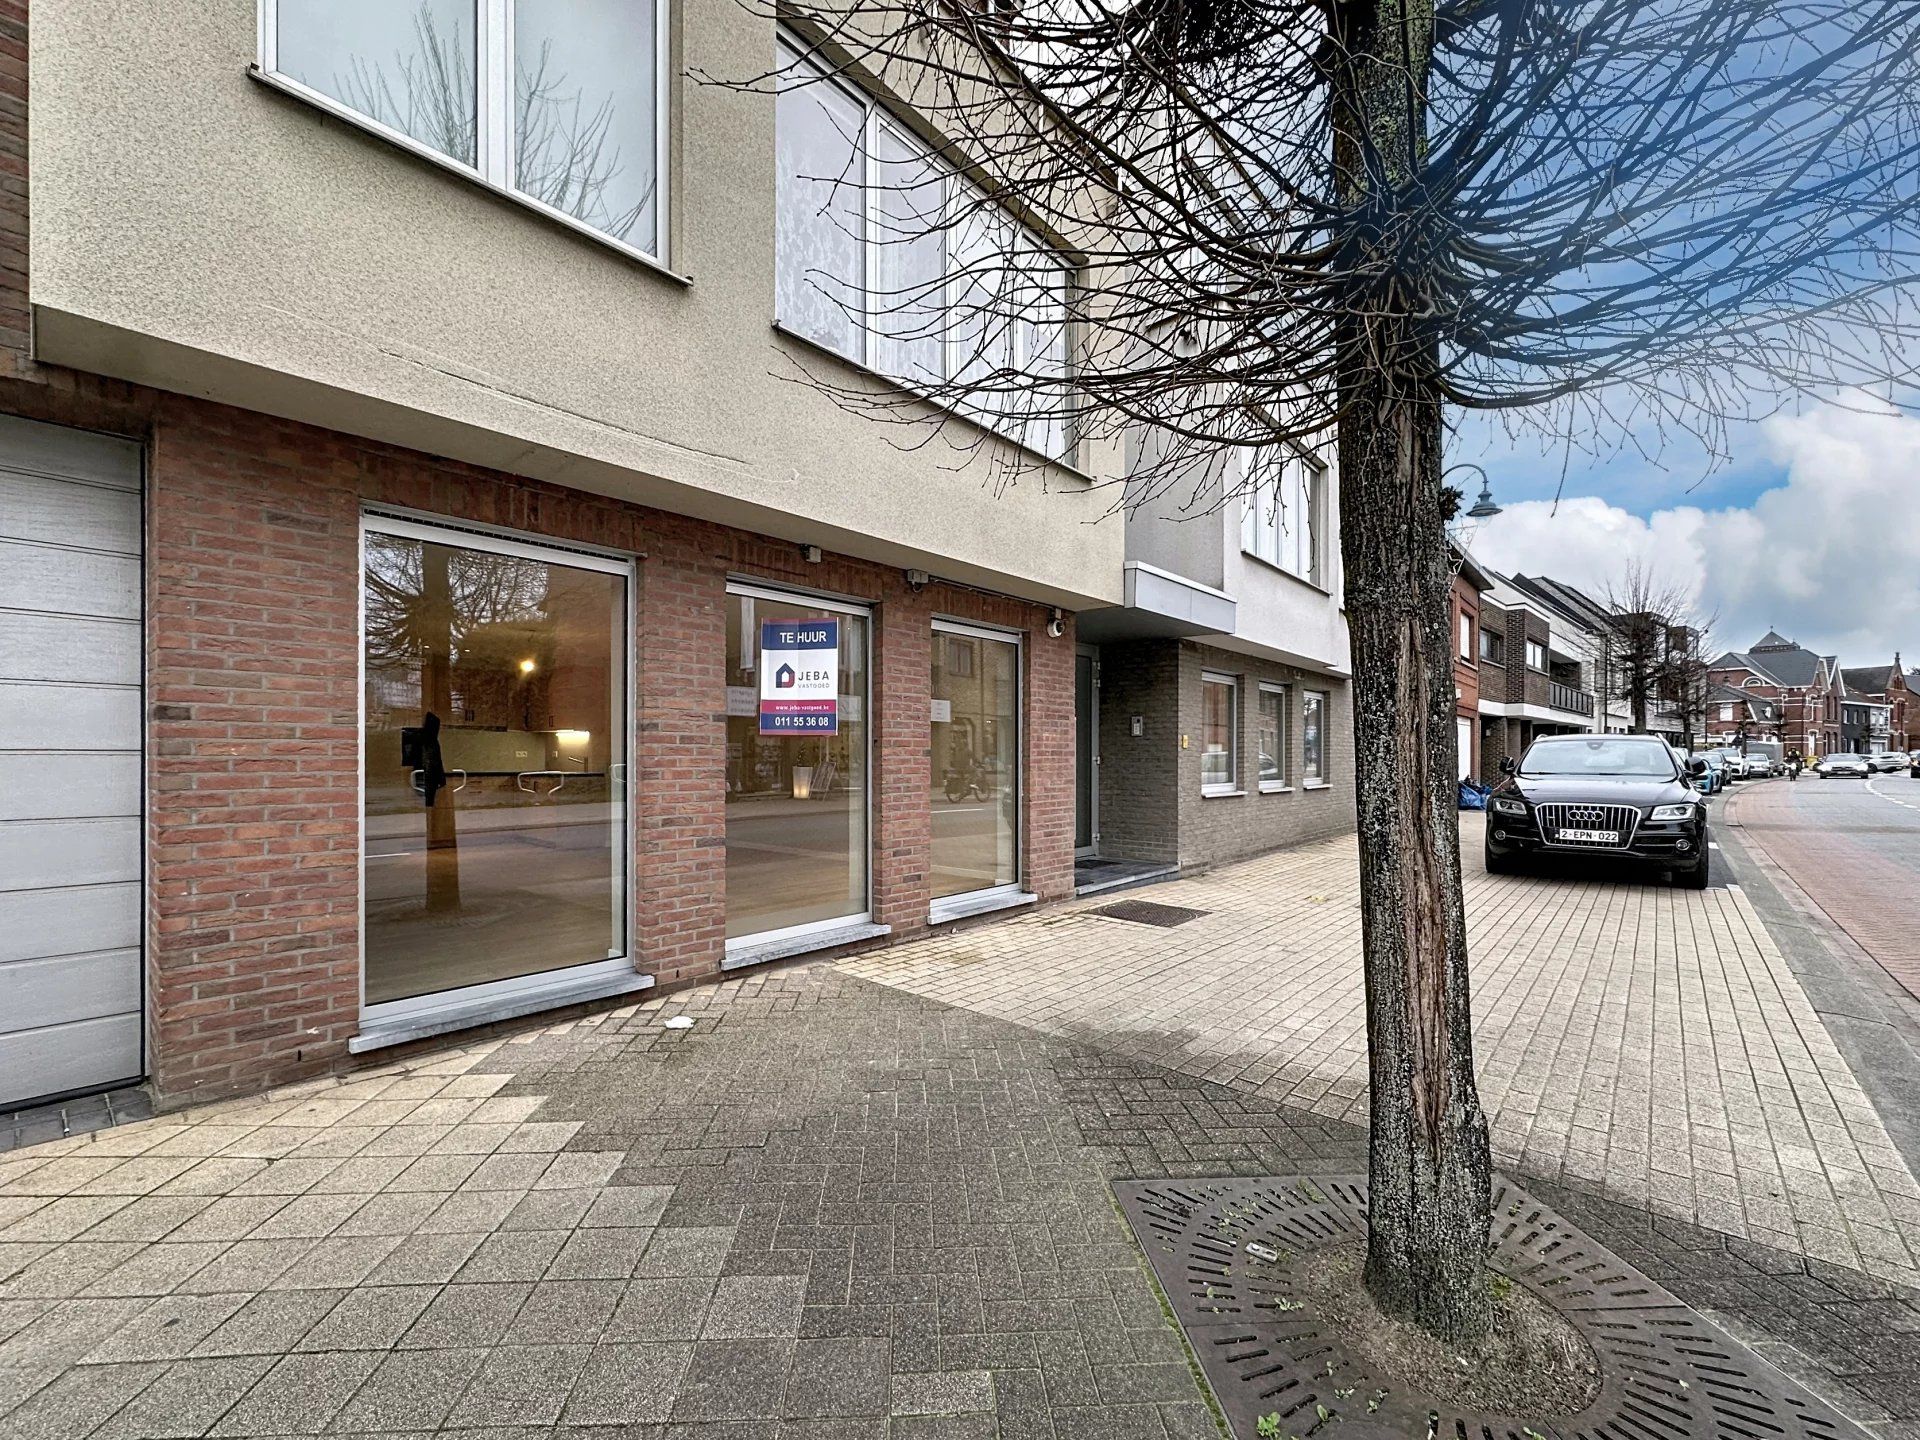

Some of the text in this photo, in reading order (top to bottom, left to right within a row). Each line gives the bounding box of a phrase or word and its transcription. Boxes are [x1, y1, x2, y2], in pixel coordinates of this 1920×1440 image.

[780, 631, 827, 643] TE HUUR
[798, 670, 830, 681] JEBA
[775, 716, 829, 727] 011 55 36 08
